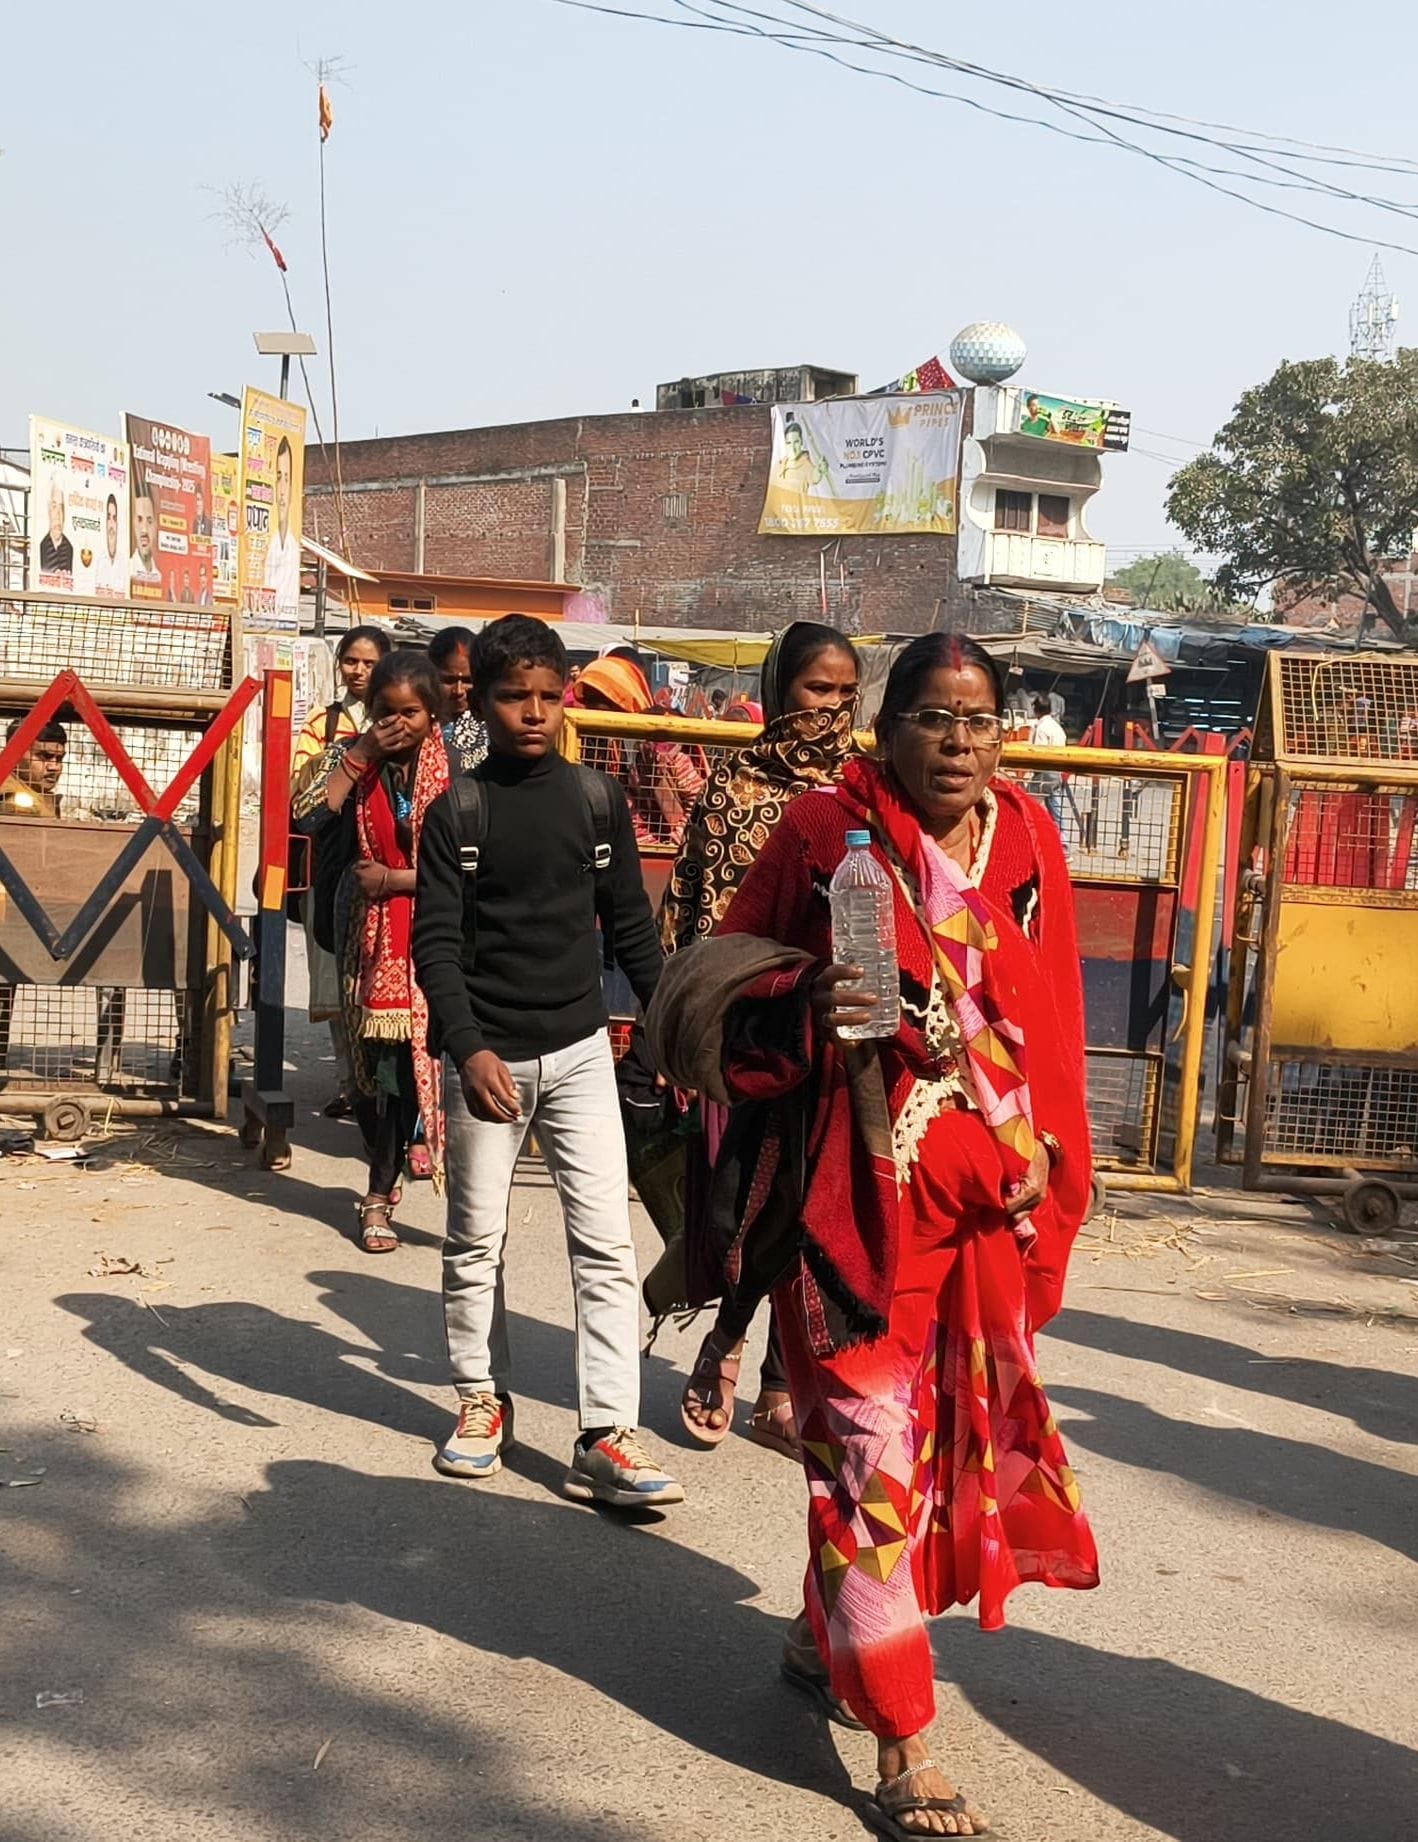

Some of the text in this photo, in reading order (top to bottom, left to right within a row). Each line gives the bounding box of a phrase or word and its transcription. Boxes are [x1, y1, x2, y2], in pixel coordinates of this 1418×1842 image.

[914, 402, 959, 416] PRINCE
[845, 437, 884, 448] WORLD'S
[862, 449, 885, 459] CPVC
